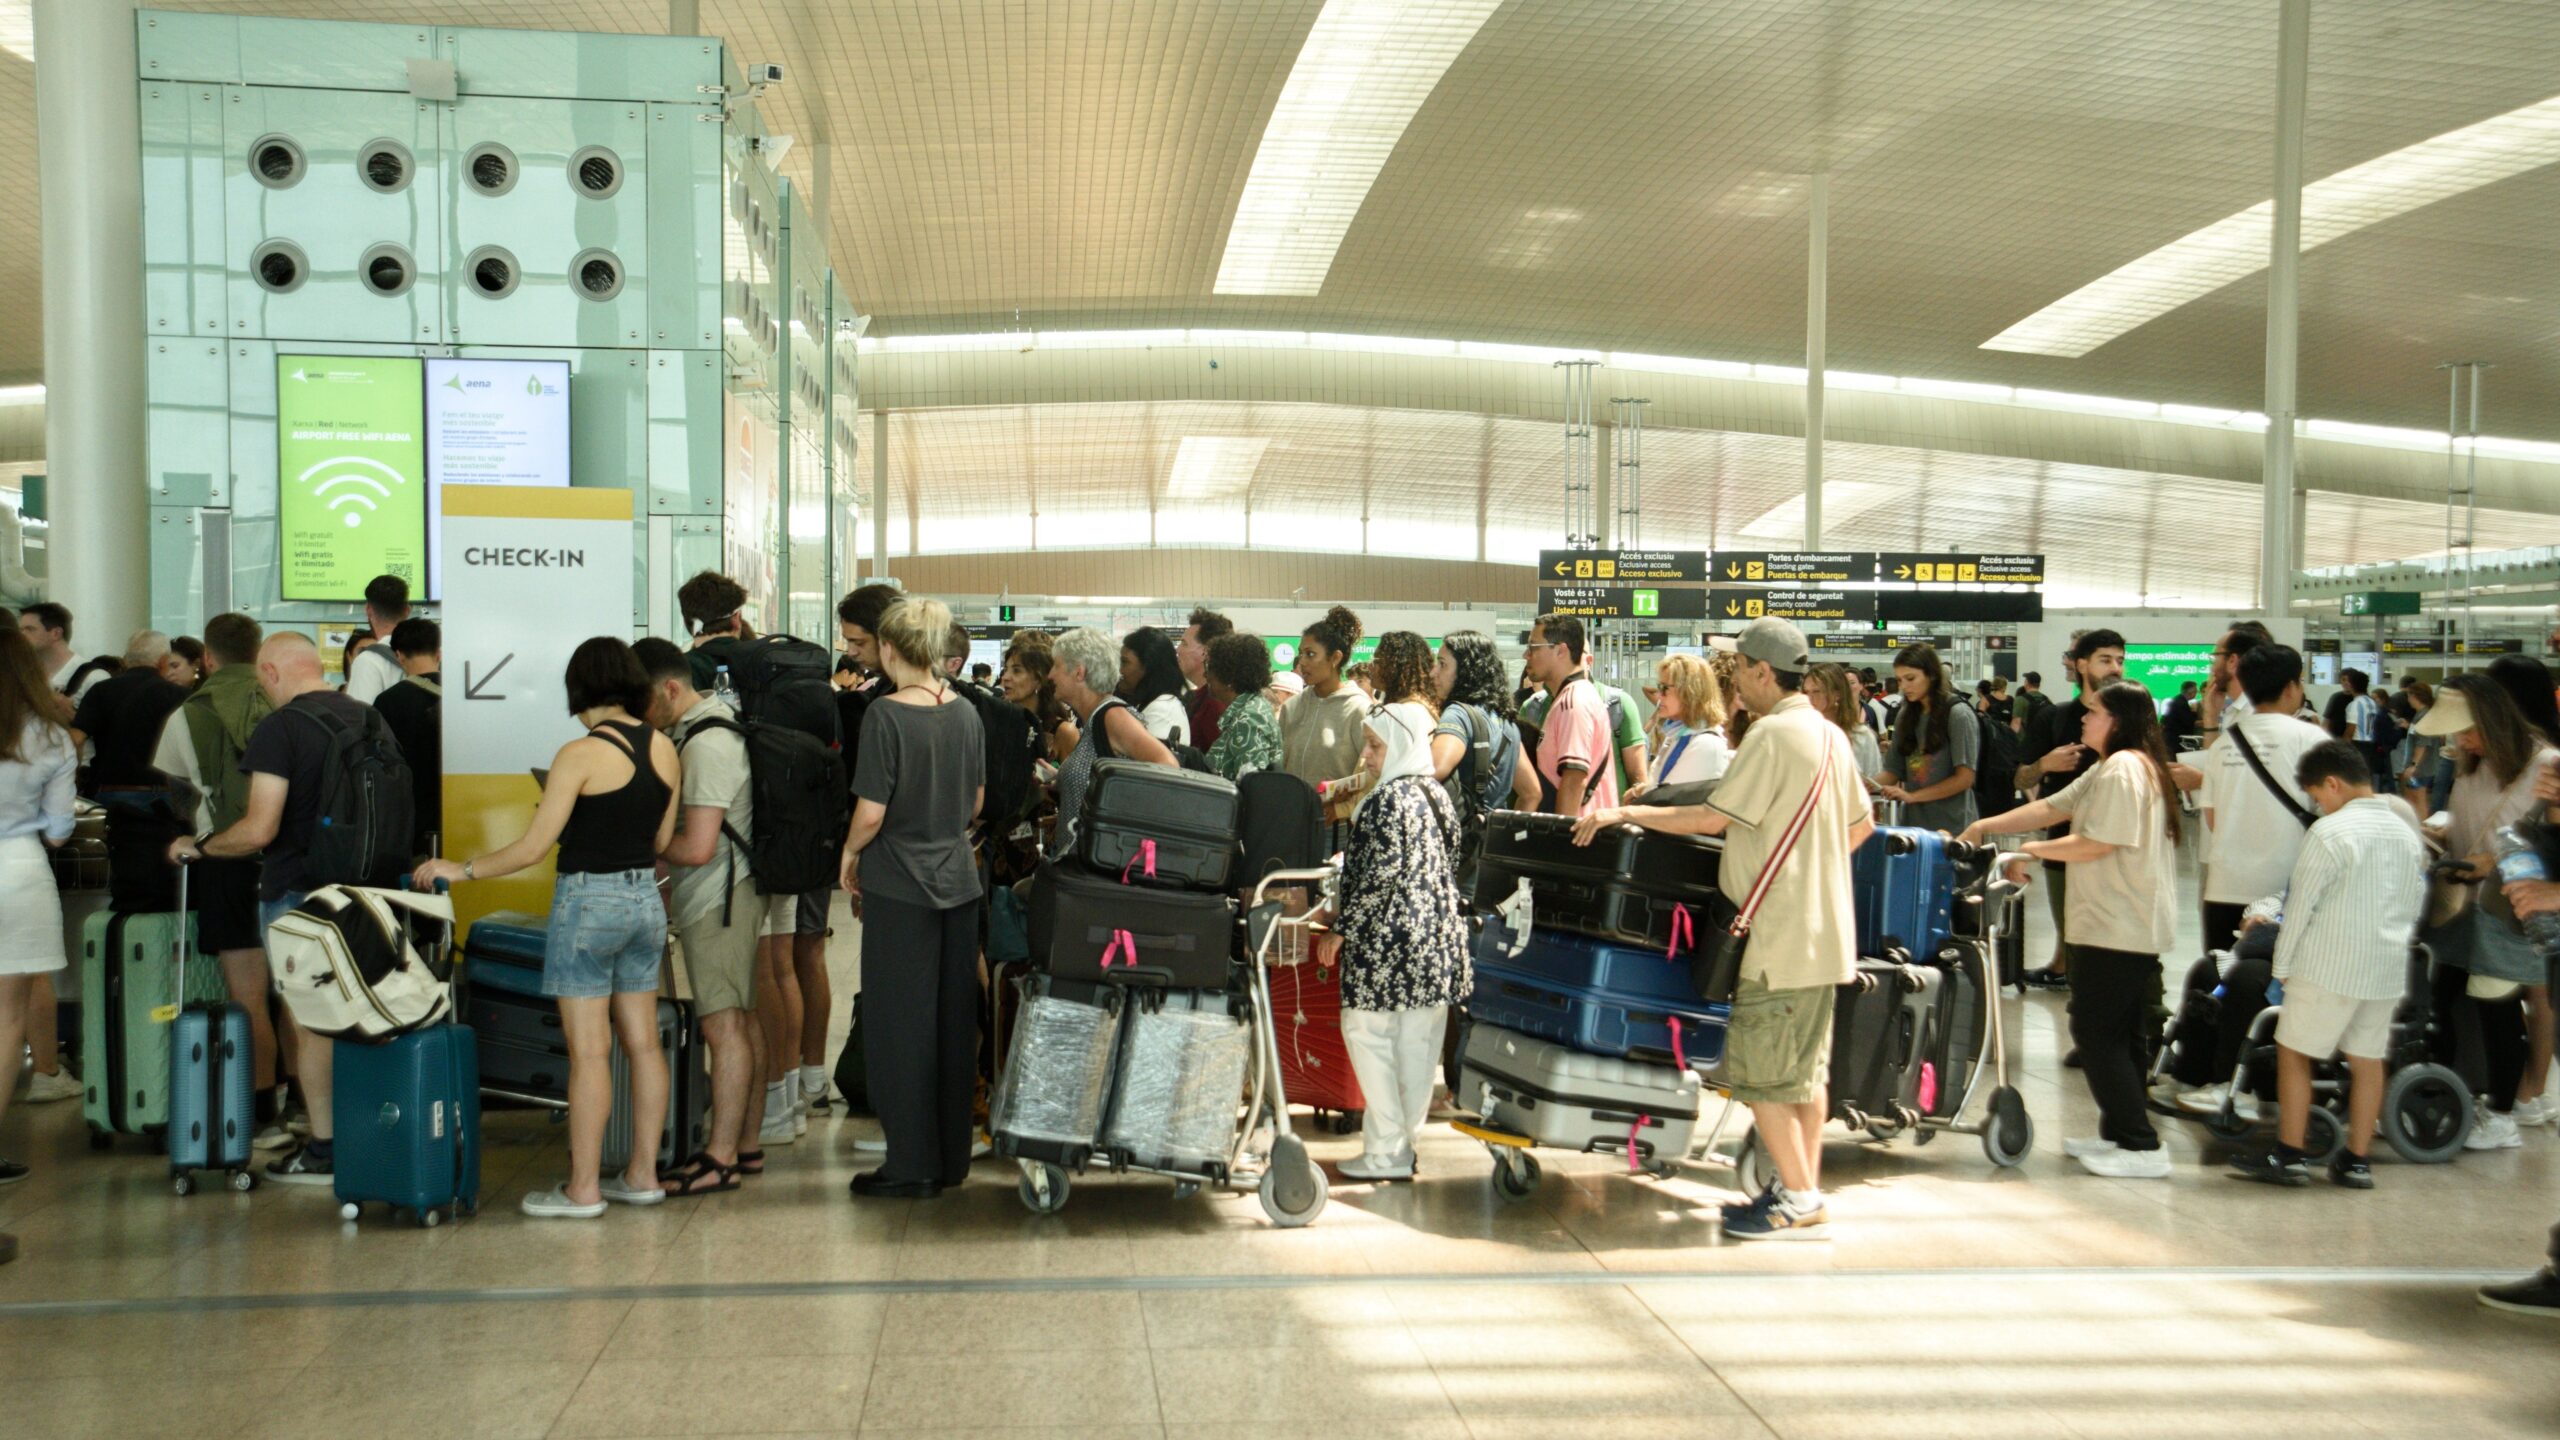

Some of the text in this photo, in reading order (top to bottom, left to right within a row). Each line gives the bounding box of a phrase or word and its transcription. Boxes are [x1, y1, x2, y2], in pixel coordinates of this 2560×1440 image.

[466, 380, 492, 389] aena
[318, 420, 334, 428] Red
[292, 430, 412, 442] AIRPORT FREE WIFI AENA
[312, 551, 333, 560] gratis
[464, 547, 584, 567] CHECK-IN
[1619, 551, 1675, 561] Accés exclusiu
[1768, 553, 1852, 562] Portes d'embarcament
[1980, 555, 2035, 564] Accés exclusiu
[1768, 562, 1815, 571] Boarding gates
[1619, 569, 1683, 578] Acceso exclusivo
[1767, 571, 1848, 580] Puertas de embarque
[1979, 573, 2006, 581] Acceso
[1554, 588, 1575, 597] Vostè
[1577, 588, 1586, 597] és
[1595, 589, 1606, 597] T1
[1768, 591, 1844, 601] Control de seguretat
[1634, 594, 1658, 611] T1
[1768, 600, 1817, 608] Security control
[1553, 606, 1576, 615] Usted
[1577, 606, 1595, 615] está
[1607, 607, 1618, 615] T1
[1767, 608, 1845, 618] Control de seguridad
[2155, 651, 2197, 661] estimado
